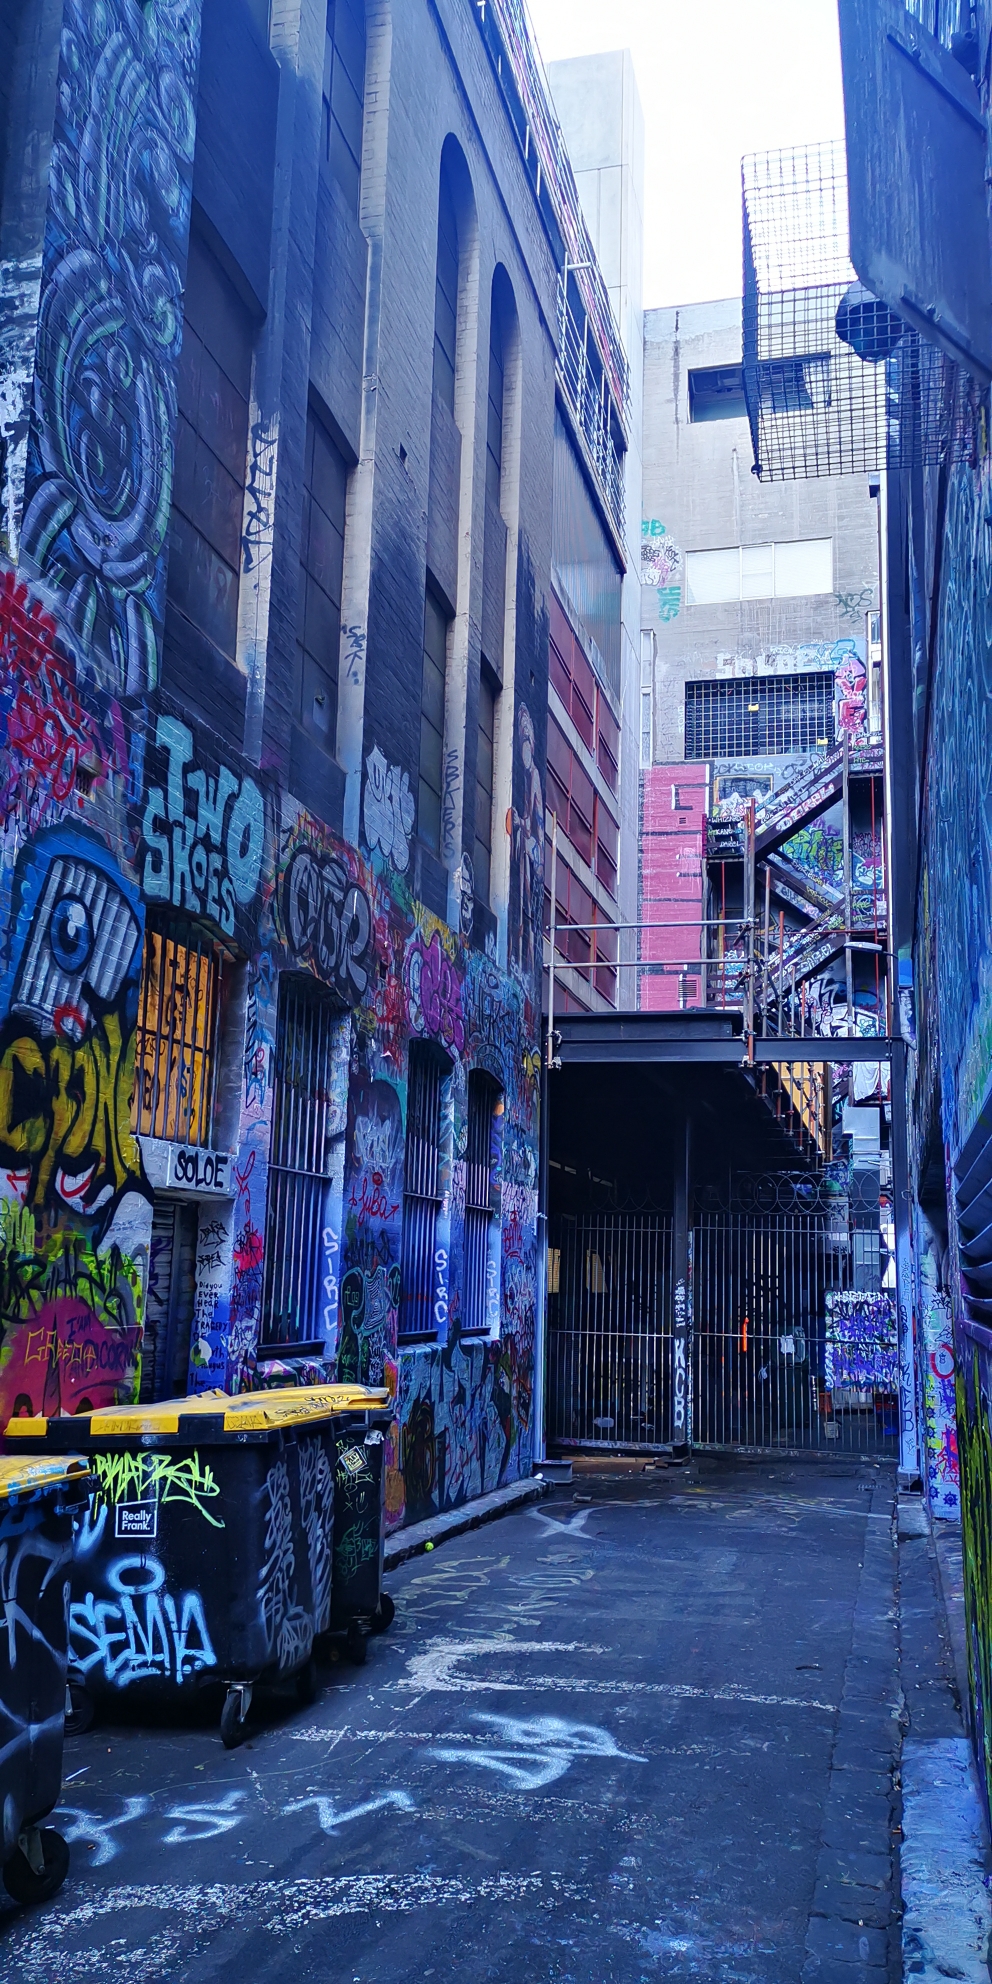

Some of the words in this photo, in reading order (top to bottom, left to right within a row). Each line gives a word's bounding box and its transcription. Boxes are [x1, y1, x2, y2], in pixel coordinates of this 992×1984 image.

[156, 714, 264, 904] TWO
[143, 786, 235, 937] SHOES
[174, 1149, 229, 1188] SOLOE
[122, 1510, 152, 1522] Really
[122, 1520, 151, 1531] Frank.
